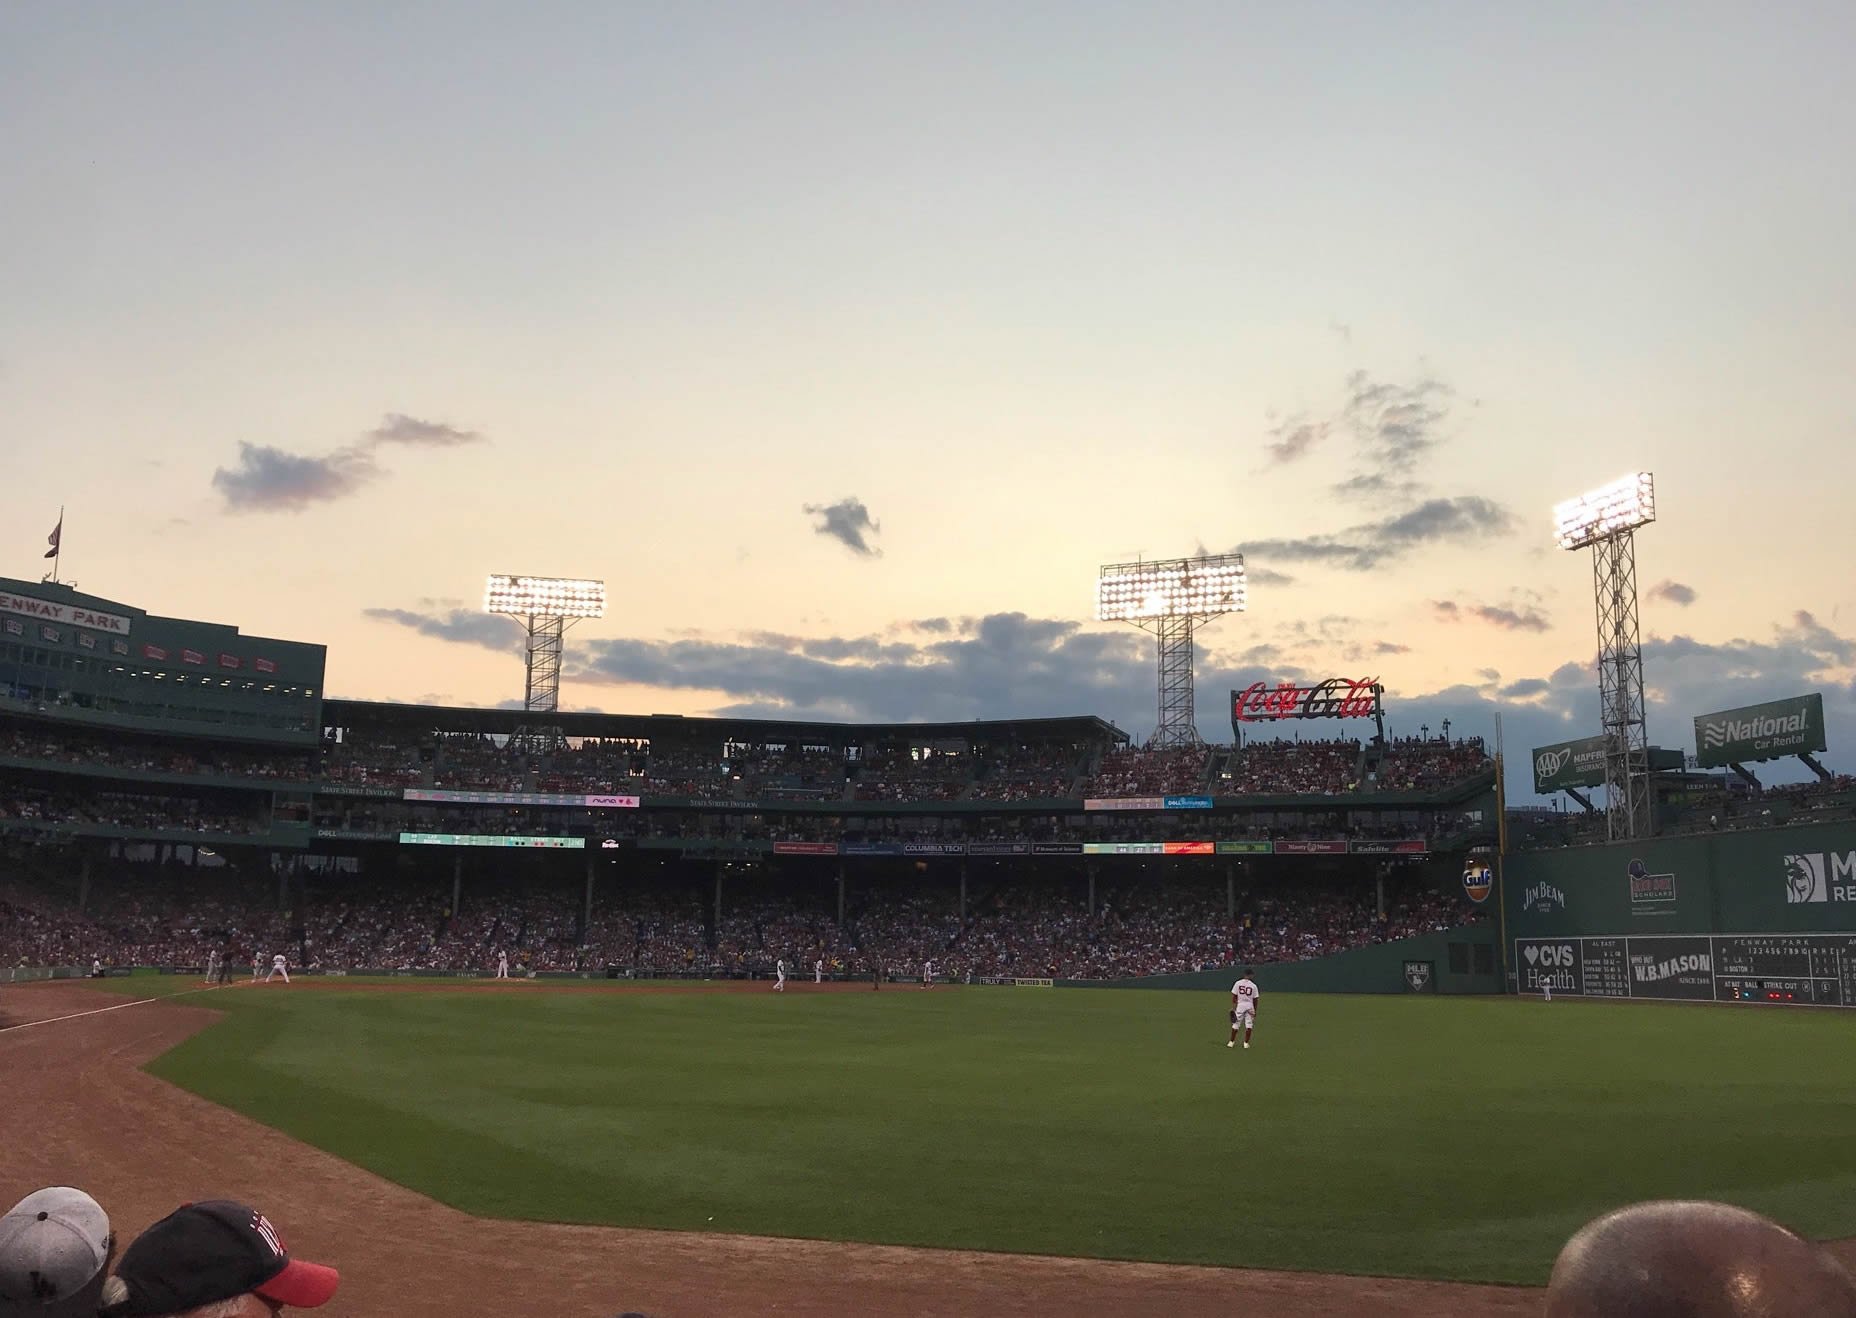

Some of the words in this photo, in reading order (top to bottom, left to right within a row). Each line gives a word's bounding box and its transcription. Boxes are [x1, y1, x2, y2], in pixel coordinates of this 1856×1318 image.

[0, 596, 62, 618] ENWAY
[72, 610, 121, 630] PARK
[1726, 708, 1807, 743] National
[1754, 740, 1770, 750] Car
[1773, 733, 1805, 748] Rental
[1539, 753, 1559, 776] AAA
[341, 786, 363, 795] STREET
[366, 788, 396, 797] PAVILION
[1464, 869, 1491, 886] Gulf
[1523, 887, 1538, 911] JIM
[1540, 880, 1566, 909] BEAM
[1540, 945, 1574, 967] CVS
[1527, 968, 1577, 989] Health
[1744, 981, 1758, 989] BALL
[1239, 985, 1253, 996] 50
